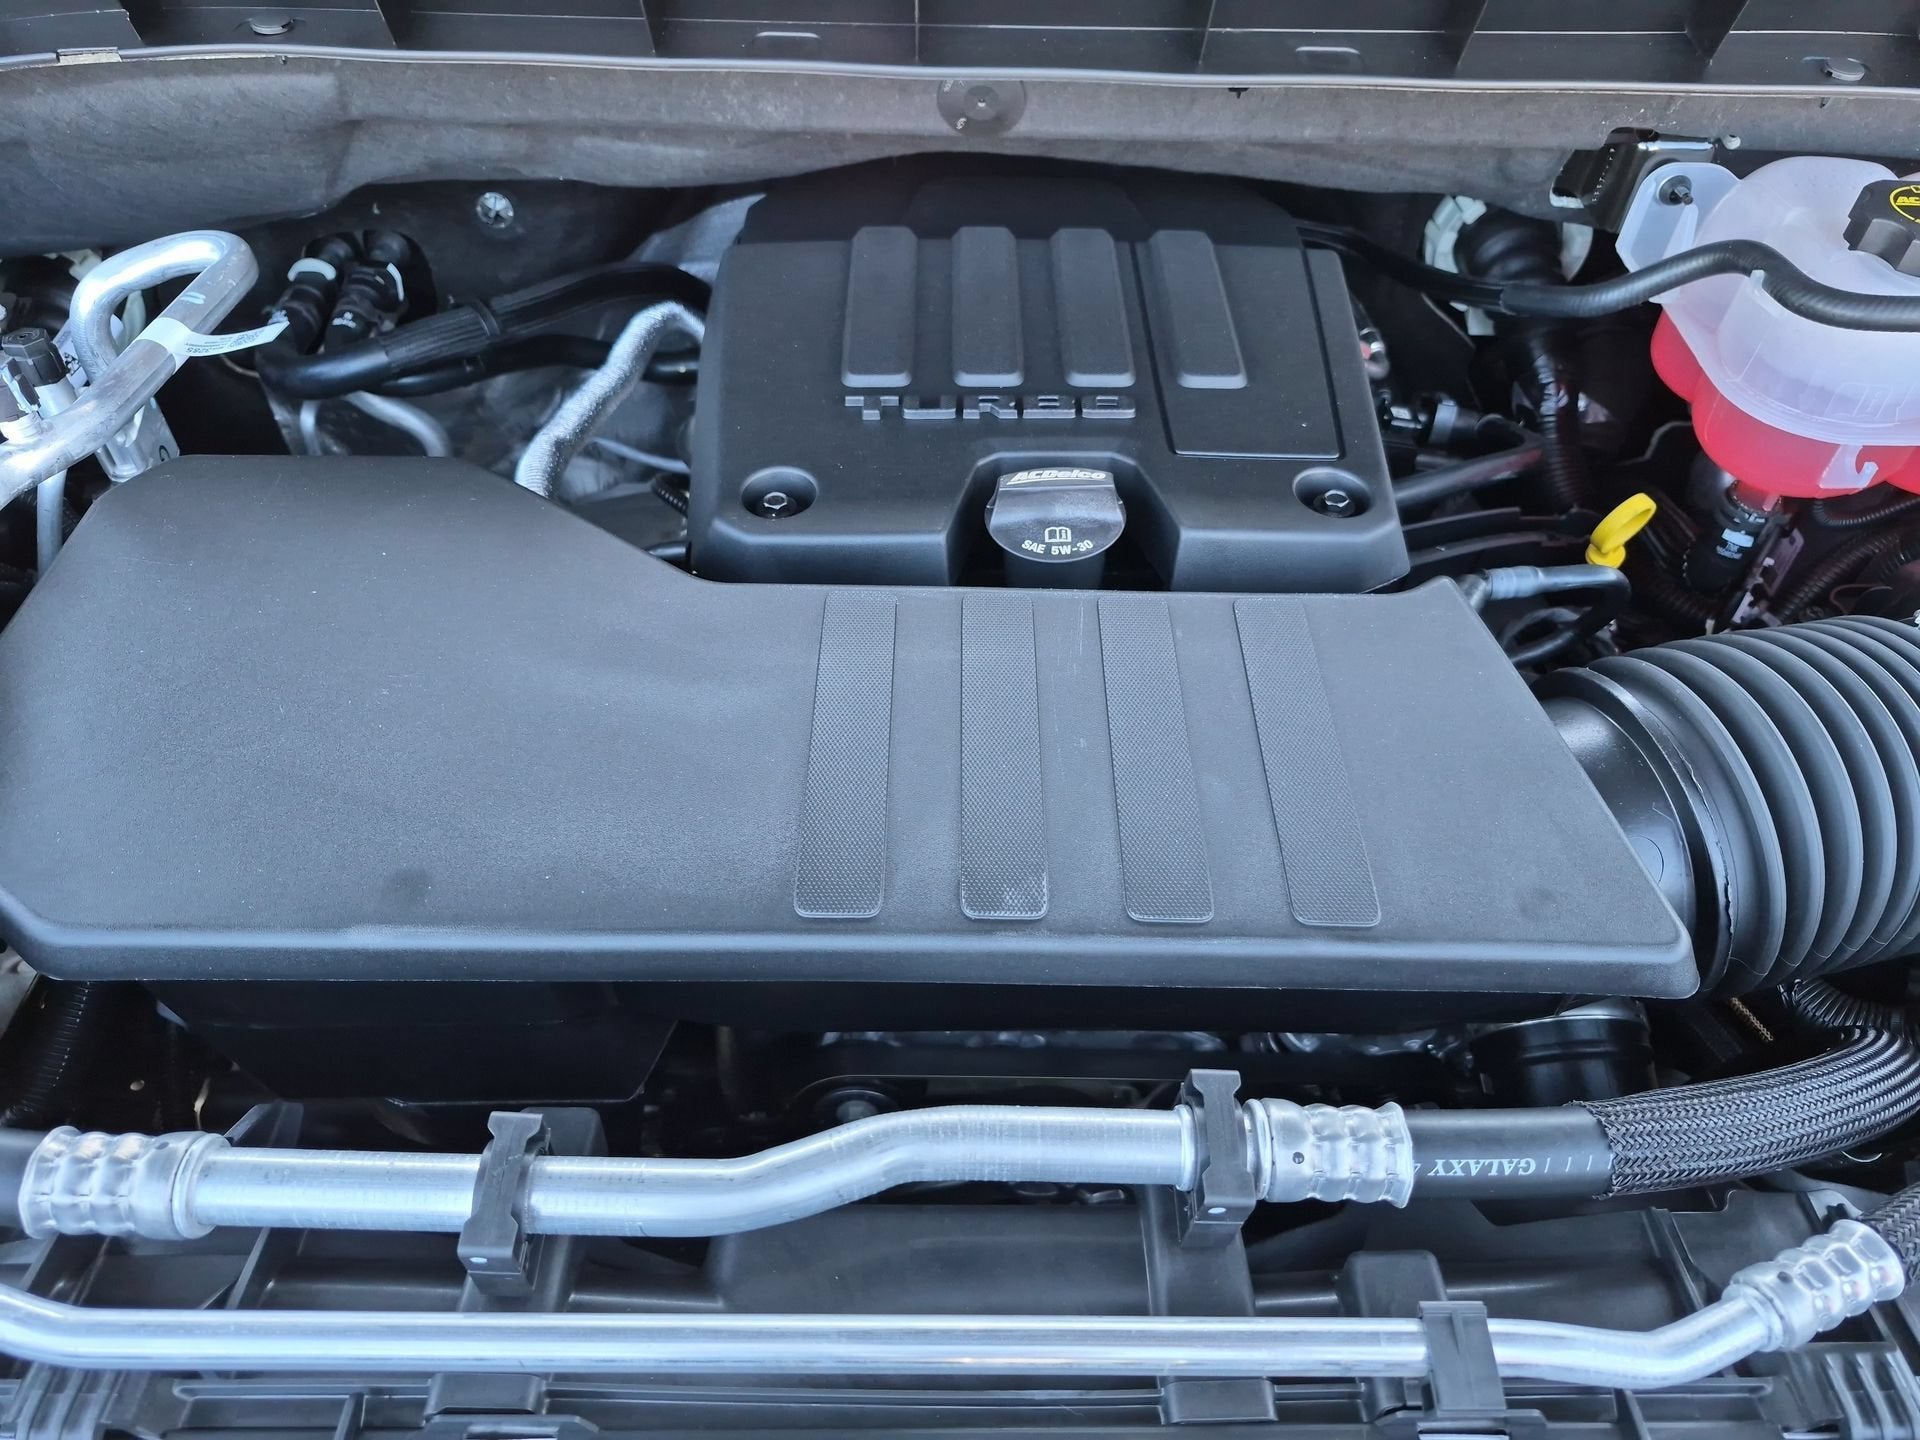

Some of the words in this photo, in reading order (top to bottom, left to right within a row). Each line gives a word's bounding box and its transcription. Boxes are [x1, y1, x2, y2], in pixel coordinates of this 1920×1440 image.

[844, 394, 1137, 421] TURBO
[1007, 469, 1107, 484] ACDelco
[1021, 539, 1046, 554] SAE
[1050, 539, 1094, 555] 5W-30
[1427, 1158, 1537, 1177] GALAXY
